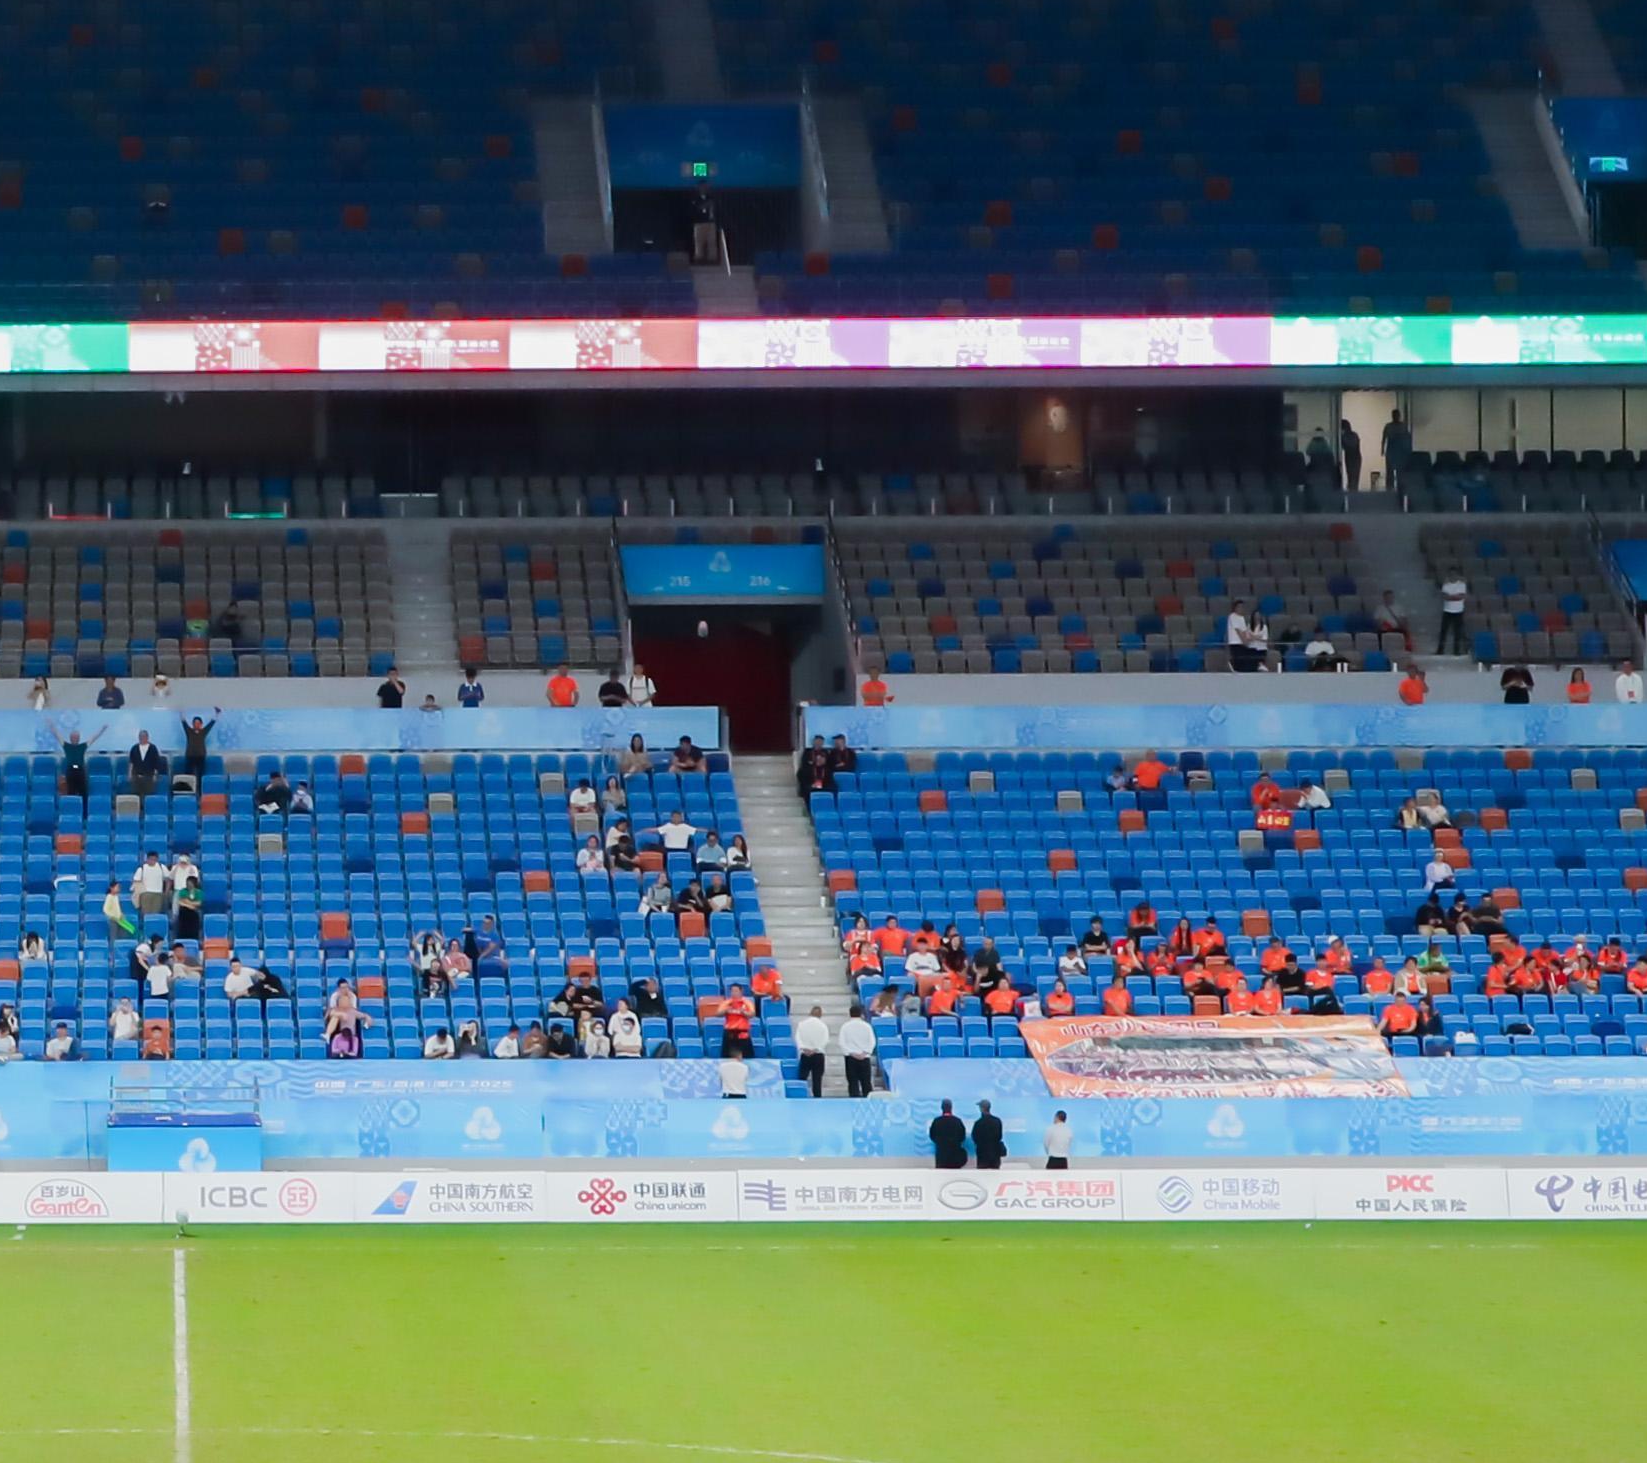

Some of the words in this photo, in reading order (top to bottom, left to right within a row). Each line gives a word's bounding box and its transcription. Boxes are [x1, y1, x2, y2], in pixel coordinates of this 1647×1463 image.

[430, 1183, 533, 1199] 中国南方航空
[634, 1183, 705, 1198] 中国联通
[995, 1180, 1115, 1198] 广汽集团
[1202, 1178, 1280, 1196] 中国移动
[1386, 1175, 1434, 1192] PICC
[40, 1184, 86, 1199] 百岁山
[201, 1187, 267, 1208] ICBC
[795, 1185, 923, 1203] 中国南方电网
[428, 1202, 459, 1213] CHINA
[460, 1199, 534, 1212] SOUTHERN
[634, 1201, 665, 1210] China
[667, 1201, 707, 1210] unicom
[994, 1197, 1037, 1208] GAC
[1041, 1198, 1115, 1208] GROUP
[1203, 1199, 1237, 1210] China
[1239, 1198, 1281, 1210] Mobile
[1356, 1199, 1467, 1212] 中国人民保险
[1584, 1203, 1621, 1213] CHINA
